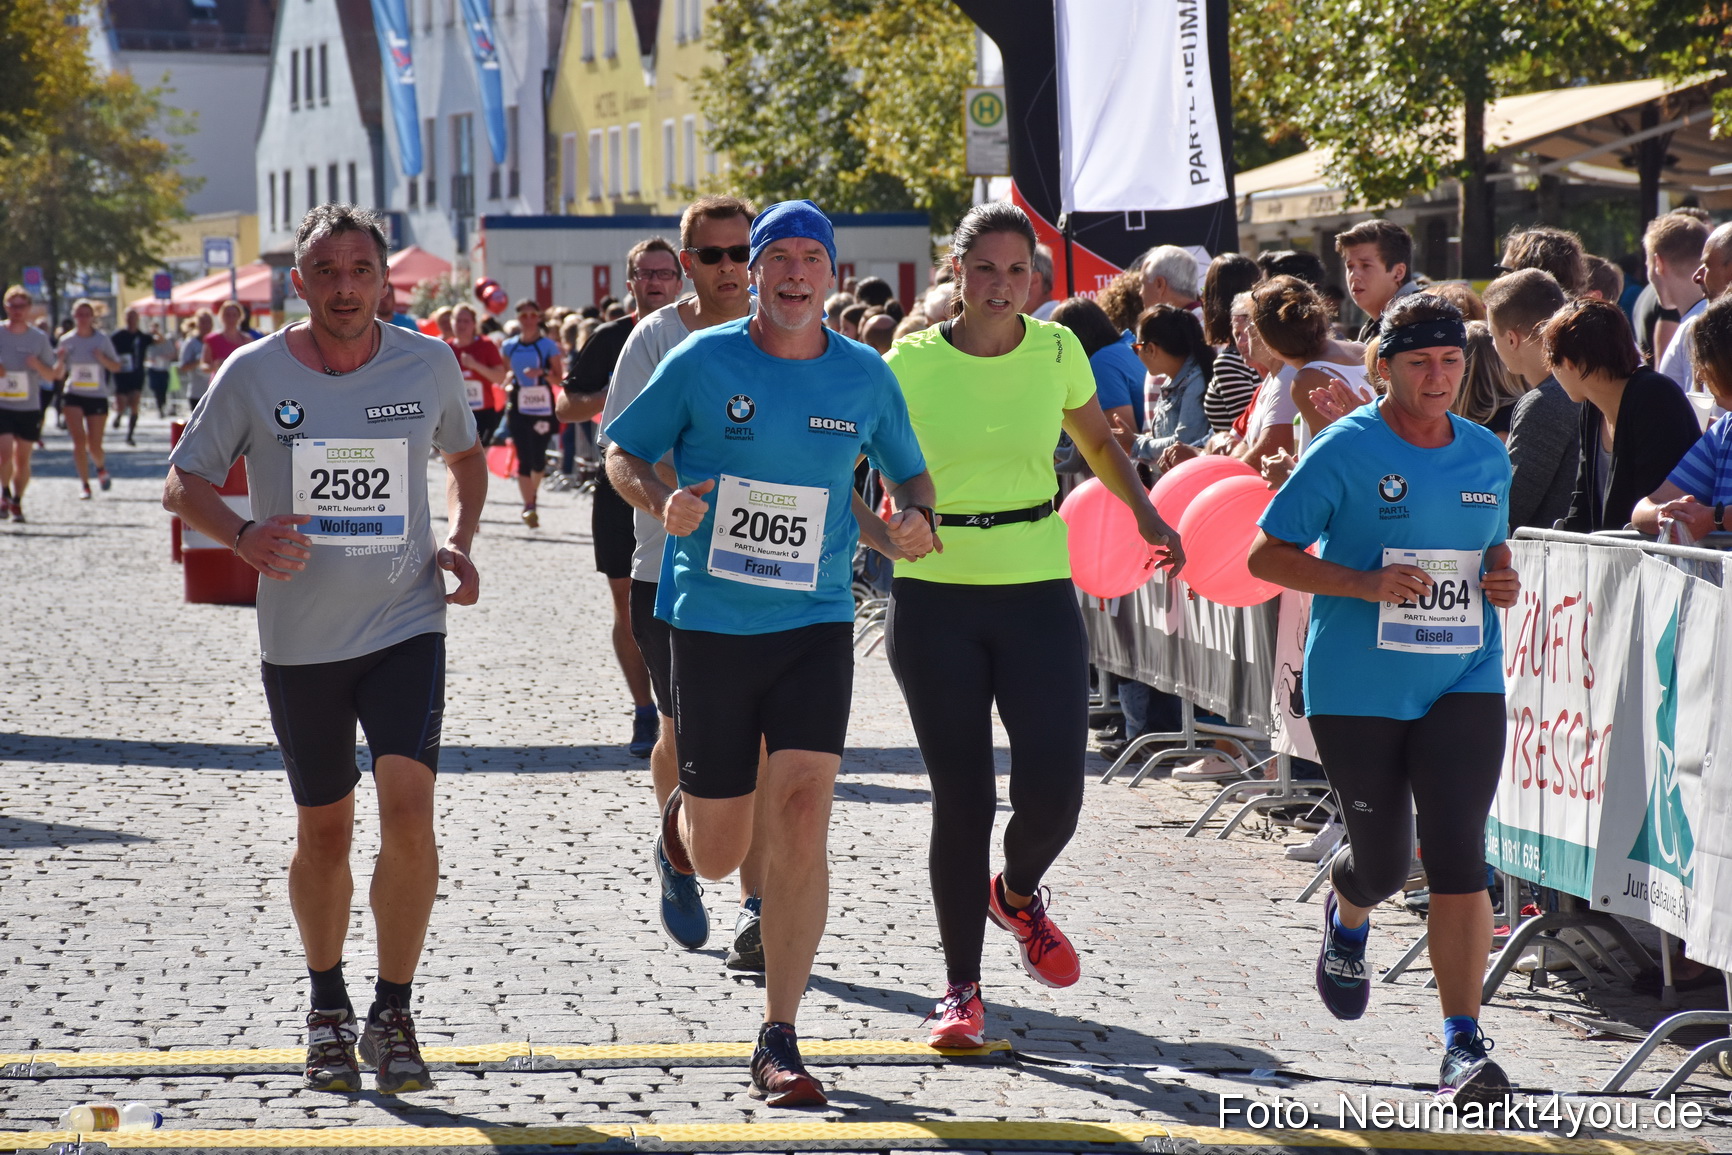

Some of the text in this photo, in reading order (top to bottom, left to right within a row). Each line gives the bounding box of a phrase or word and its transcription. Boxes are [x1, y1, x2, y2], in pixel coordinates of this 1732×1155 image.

[1055, 339, 1064, 364] Reebok
[365, 401, 424, 420] BOCK
[725, 426, 755, 436] PARTL
[808, 416, 859, 434] BOCK
[277, 432, 309, 443] PARTL
[327, 448, 375, 459] BOCK
[310, 468, 390, 500] 2582
[749, 490, 797, 507] BOCK
[1460, 491, 1498, 506] BOCK
[1379, 506, 1410, 515] PARTL
[1379, 512, 1410, 520] Neumarkt
[320, 519, 383, 536] Wolfgang
[729, 507, 807, 547] 2065
[734, 542, 789, 557] PARTL Neumarkt
[744, 559, 782, 577] Frank
[1417, 559, 1458, 571] BOCK
[1415, 628, 1454, 643] Gisela
[1622, 873, 1649, 901] Jura
